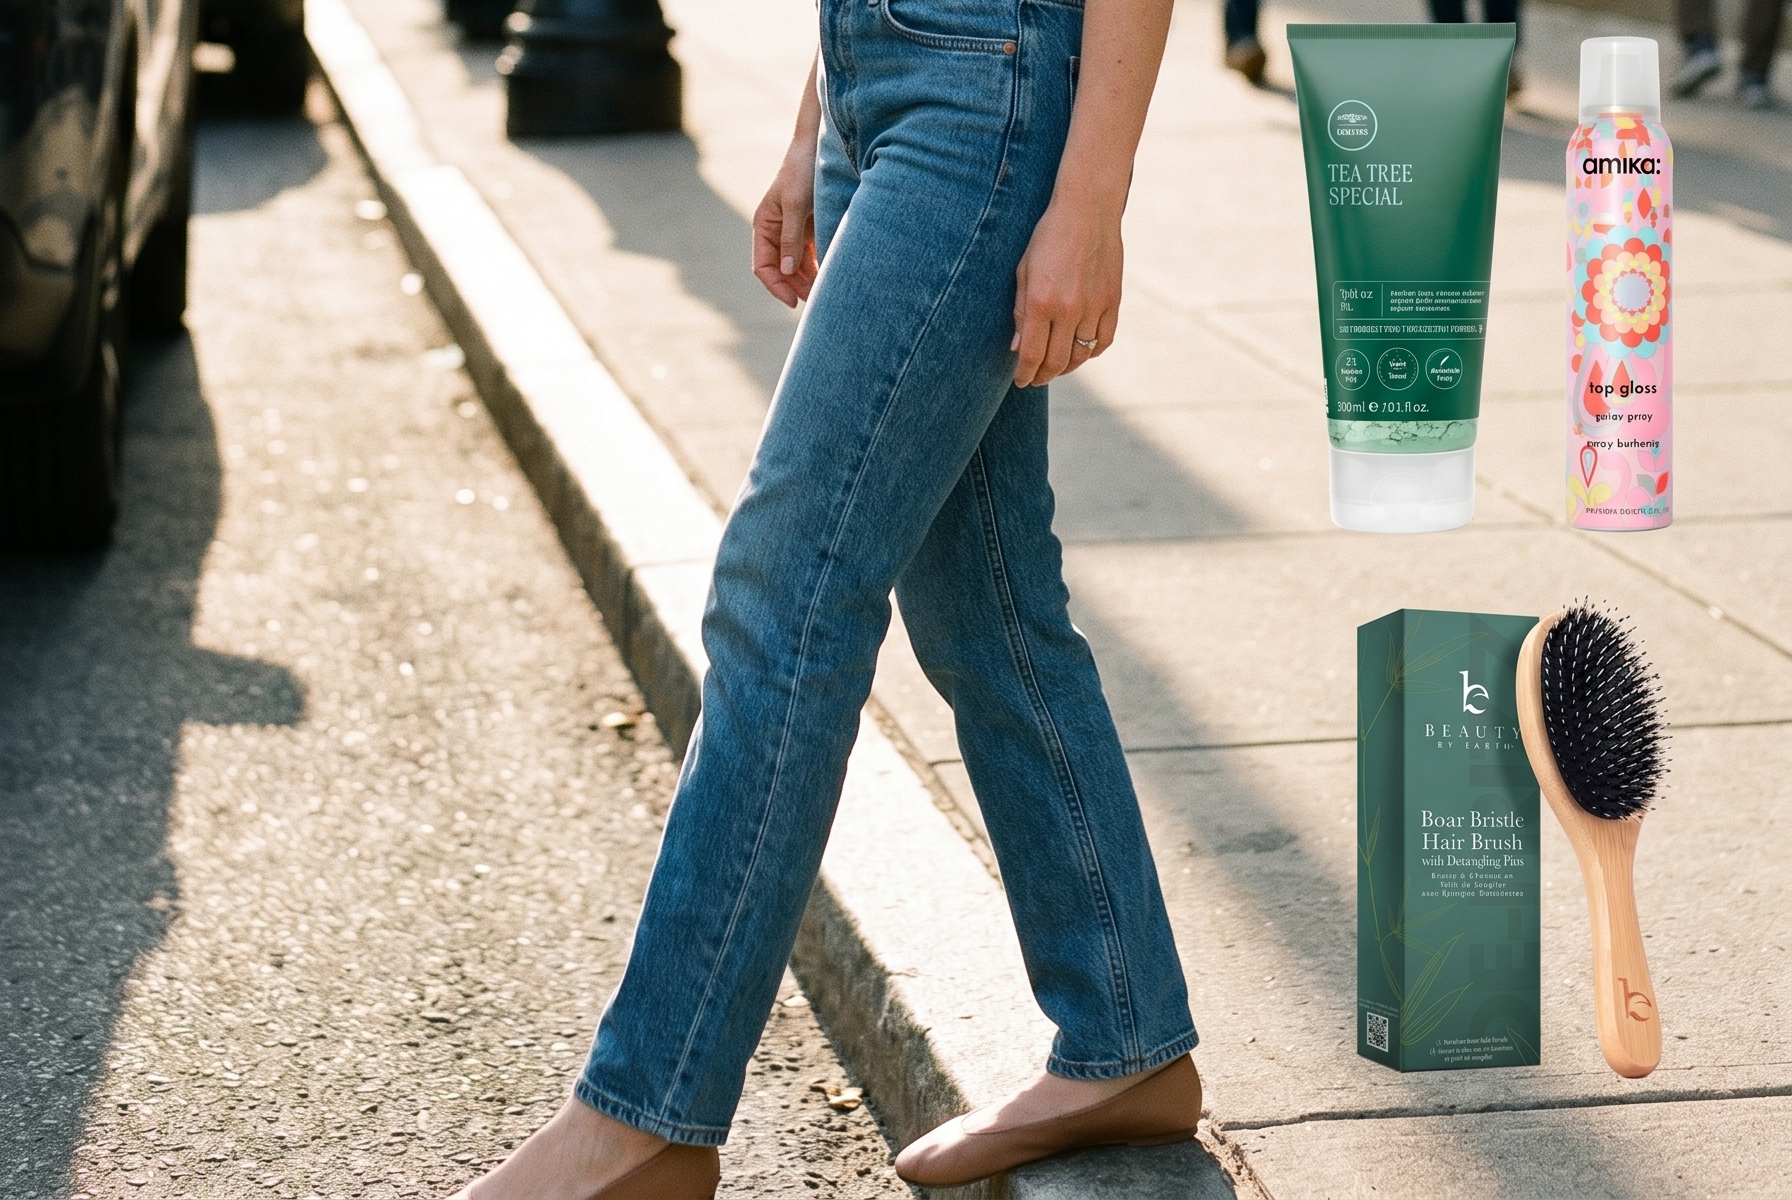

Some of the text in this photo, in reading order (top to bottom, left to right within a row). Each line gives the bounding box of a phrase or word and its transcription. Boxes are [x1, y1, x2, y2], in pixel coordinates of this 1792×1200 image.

[1327, 164, 1413, 183] TEA TREE
[1329, 187, 1403, 206] SPECIAL
[1589, 379, 1657, 398] top gloss
[1425, 723, 1520, 740] BEAUTY
[1421, 810, 1525, 828] Boar Bristle
[1422, 832, 1523, 850] Hair Brush
[1446, 854, 1502, 869] Detangling
